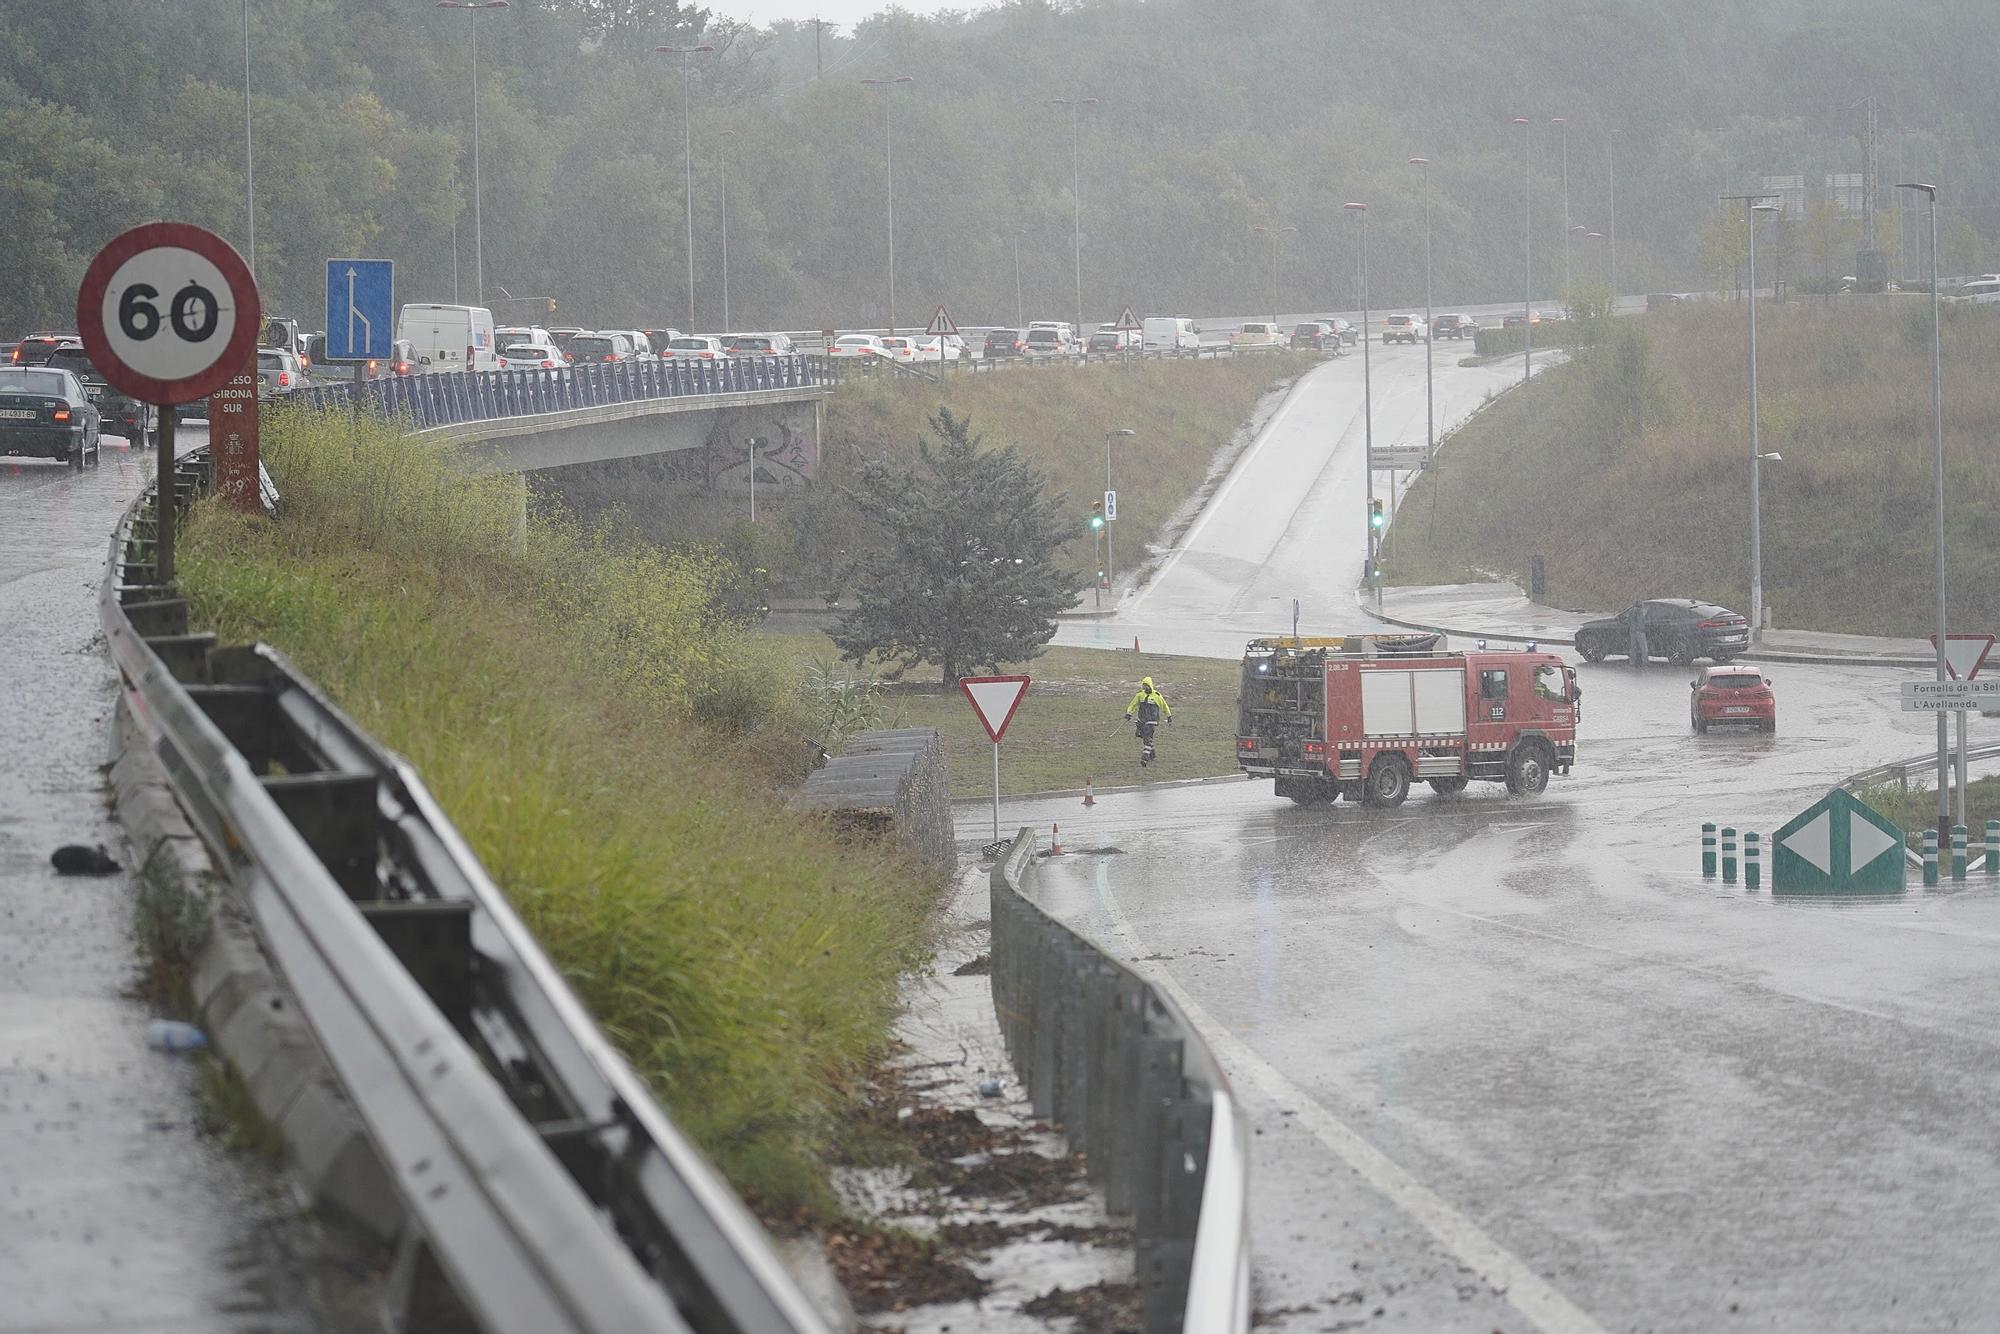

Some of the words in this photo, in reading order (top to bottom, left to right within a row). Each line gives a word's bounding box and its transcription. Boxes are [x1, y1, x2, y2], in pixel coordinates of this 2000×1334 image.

[119, 283, 219, 343] 60
[213, 389, 253, 399] GIRONA
[223, 403, 243, 413] SUR
[1913, 684, 1954, 693] Fornells
[1957, 684, 1968, 692] de
[1971, 684, 1980, 692] la
[1983, 682, 2000, 691] Sel
[1913, 700, 1977, 709] L'Avellaneda
[1491, 707, 1504, 716] 112
